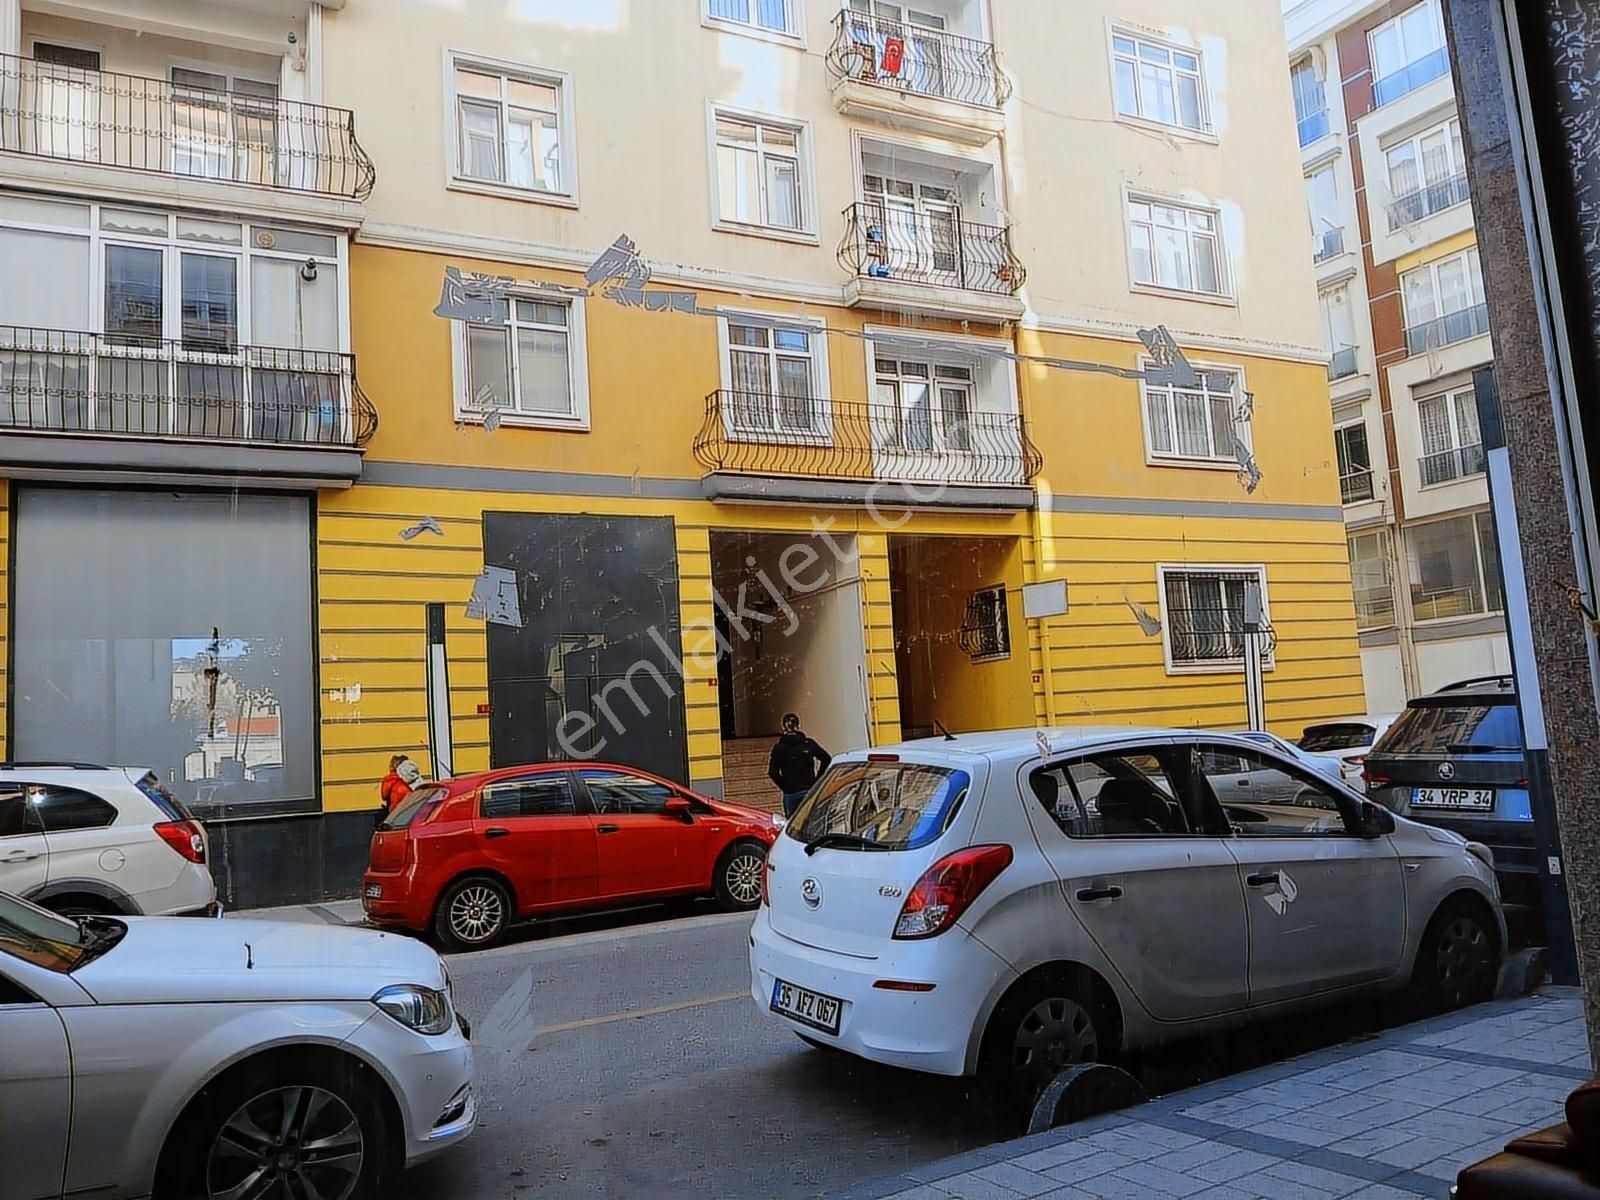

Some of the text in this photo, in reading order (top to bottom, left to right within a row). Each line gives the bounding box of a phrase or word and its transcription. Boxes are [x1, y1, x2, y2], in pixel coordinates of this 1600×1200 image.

[1420, 790, 1490, 805] 34 YRP 34
[779, 984, 793, 1008] 35
[795, 990, 815, 1017] AFZ
[816, 998, 838, 1024] 067
